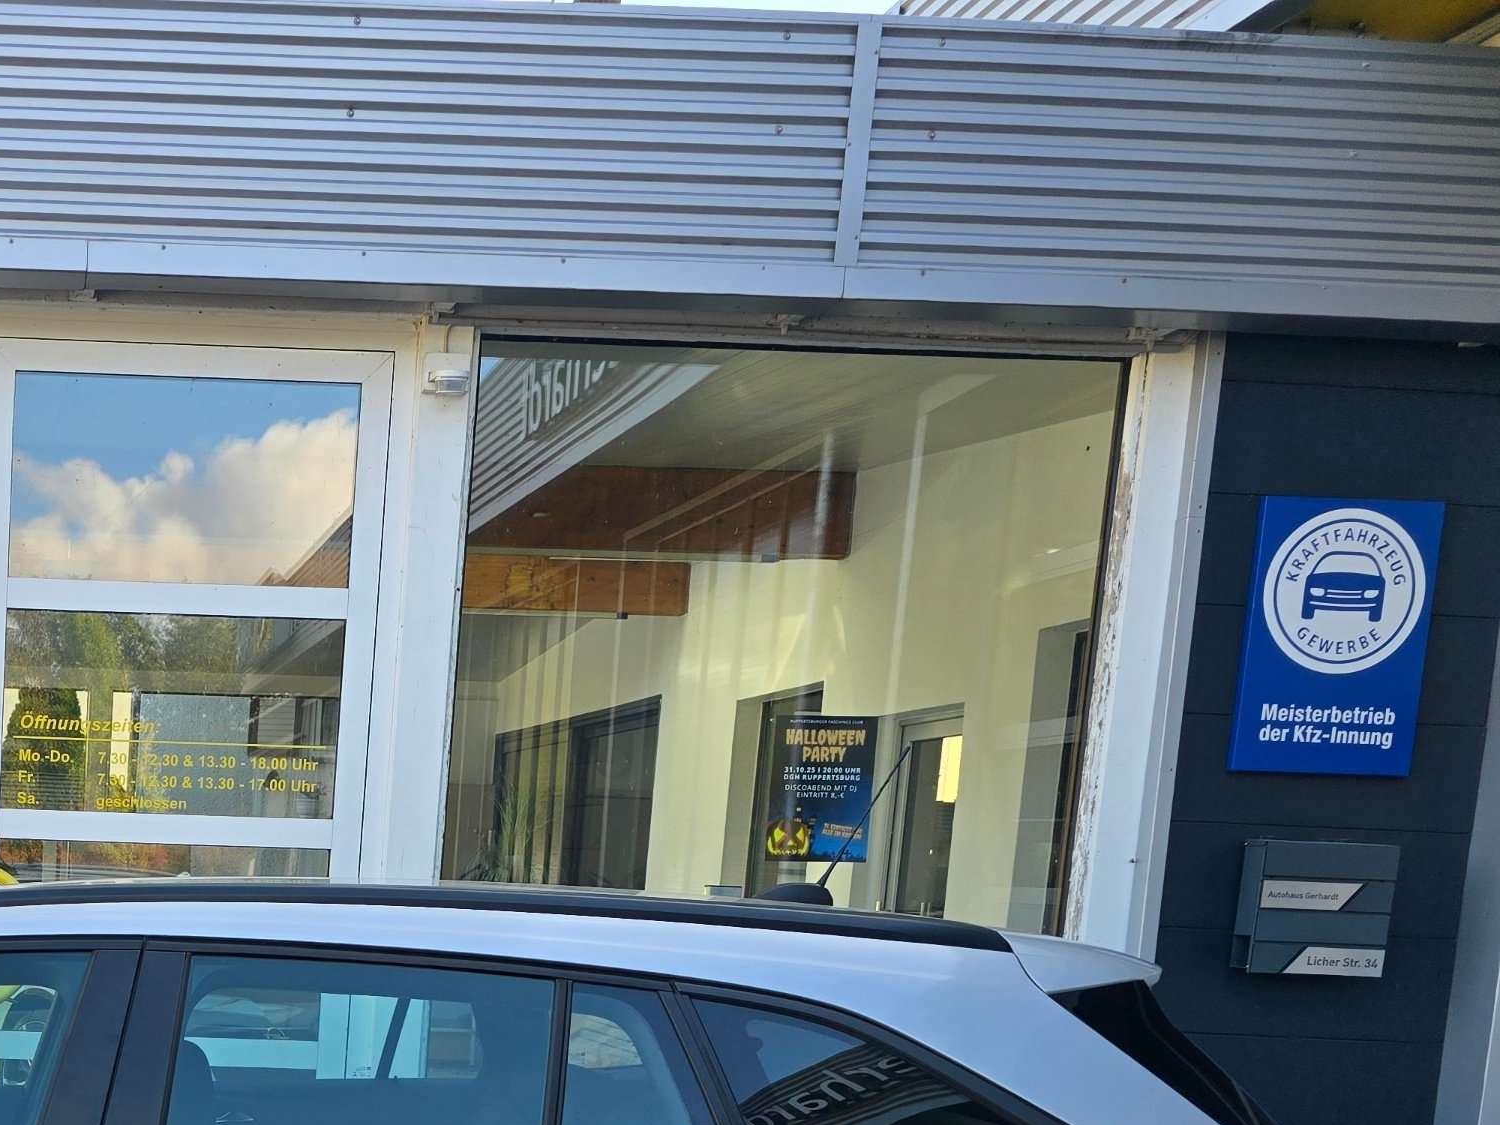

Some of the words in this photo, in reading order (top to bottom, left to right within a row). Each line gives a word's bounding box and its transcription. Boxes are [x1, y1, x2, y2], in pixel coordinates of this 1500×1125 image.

[1285, 527, 1406, 586] KRAFTFAHRZEUG
[1296, 626, 1382, 655] GEWERBE
[19, 710, 160, 735] Öffnungszeiten:
[1260, 702, 1396, 725] Meisterbetrieb
[786, 728, 866, 746] HALLOWEEN
[1259, 723, 1290, 742] der
[1292, 724, 1394, 749] Kfz-Innung
[97, 751, 127, 765] 7.30
[143, 753, 178, 767] 12.30
[183, 755, 193, 767] &
[199, 755, 236, 768] 13.30
[251, 757, 288, 770] 18.00
[292, 758, 319, 771] Uhr
[802, 746, 847, 763] PARTY
[17, 771, 36, 784] Fr.
[97, 773, 126, 786] 7.30
[141, 774, 176, 788] 12.30
[182, 776, 193, 789] &
[199, 776, 236, 790] 13.30
[250, 779, 287, 792] 17.00
[291, 780, 318, 793] Uhr
[784, 784, 832, 792] DISCOABEND
[849, 785, 858, 793] DJ
[16, 791, 40, 805] Sa.
[96, 796, 188, 811] geschlossen
[1267, 890, 1303, 900] Autohaus
[1304, 891, 1339, 901] Gerhardt
[1306, 955, 1341, 967] Licher
[1342, 957, 1361, 968] Str.
[1363, 958, 1378, 968] 34
